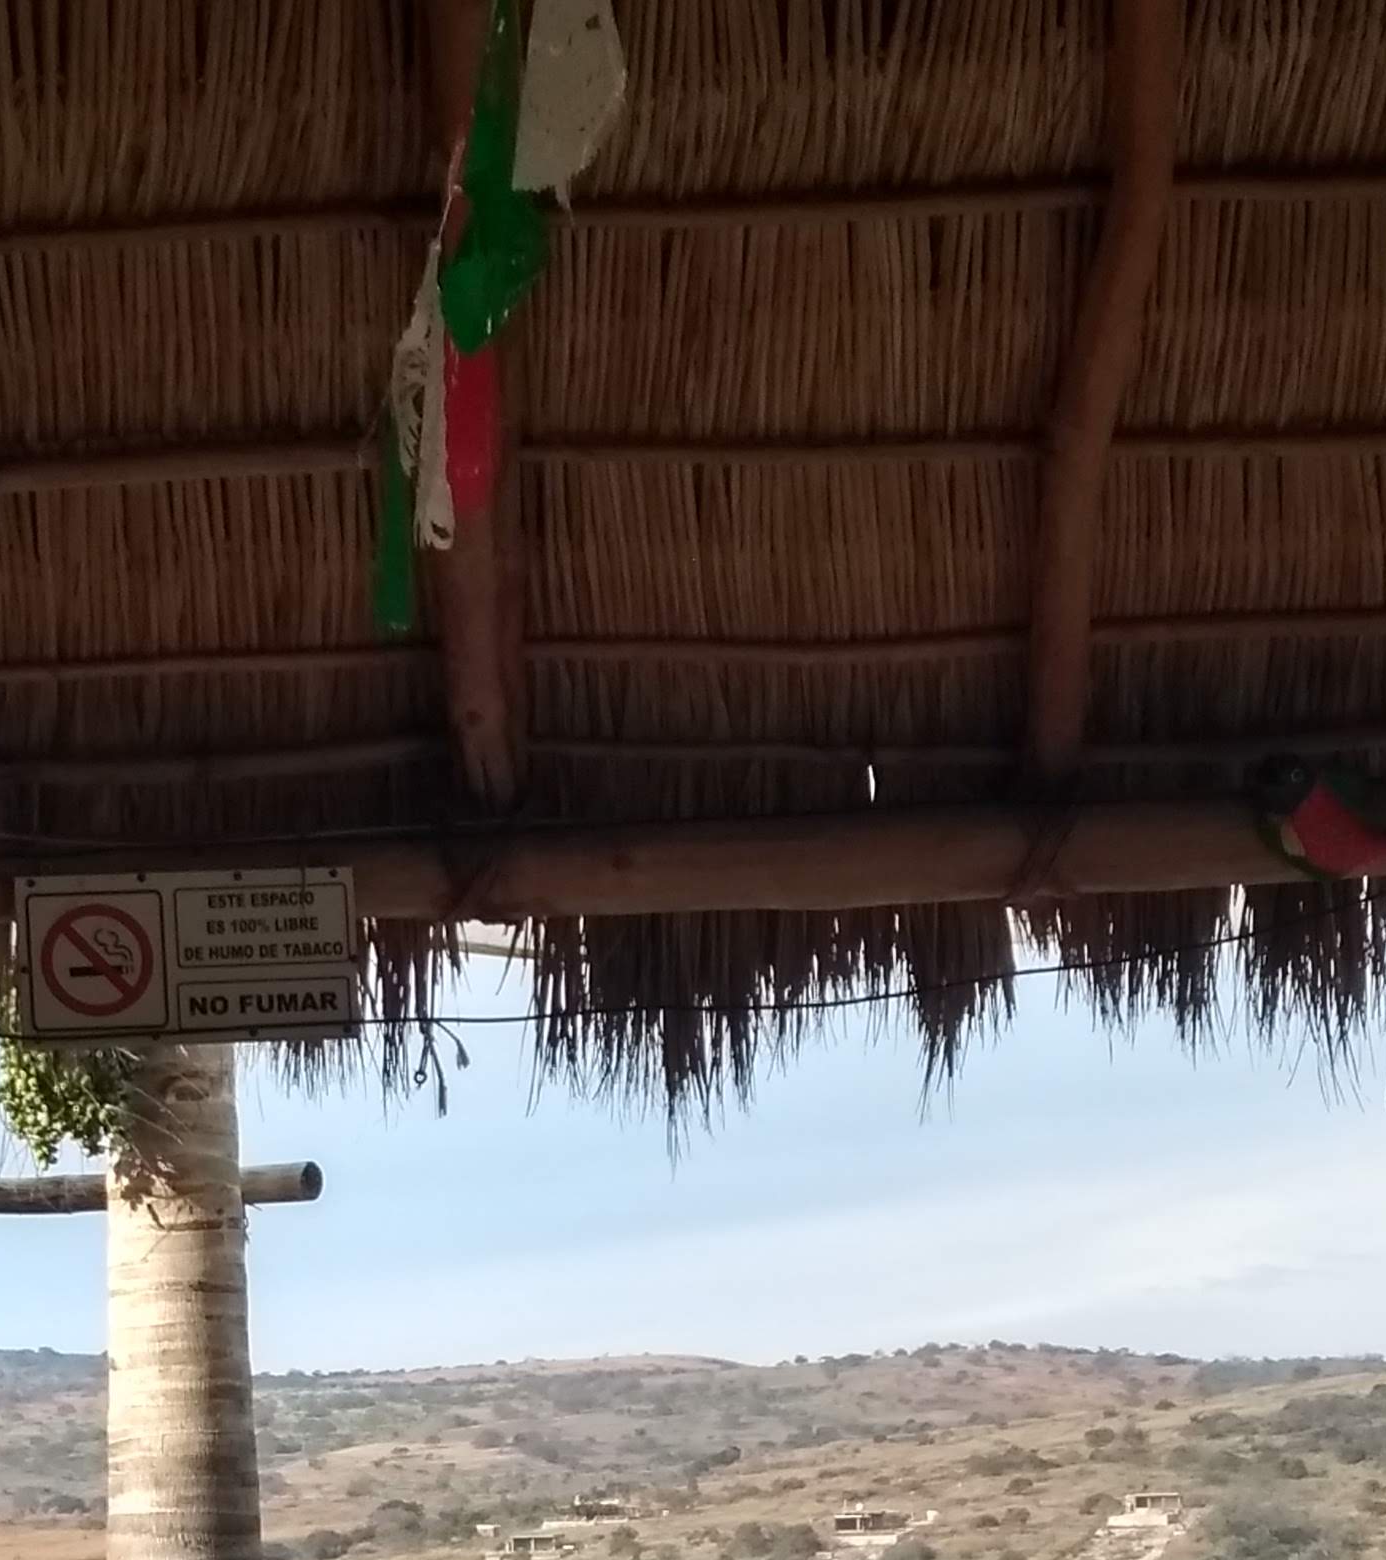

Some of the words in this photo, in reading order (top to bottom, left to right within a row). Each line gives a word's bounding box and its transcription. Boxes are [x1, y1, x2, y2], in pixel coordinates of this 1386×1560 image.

[207, 893, 246, 909] ESTE
[251, 890, 315, 908] ESPACIO
[206, 920, 225, 935] ES
[231, 918, 271, 934] 100%
[274, 916, 320, 932] LIBRE
[183, 946, 204, 961] DE
[209, 944, 254, 961] HUMO
[259, 943, 279, 959] DE
[283, 941, 343, 958] TABACO
[188, 995, 229, 1016] NO
[239, 991, 338, 1014] FUMAR
